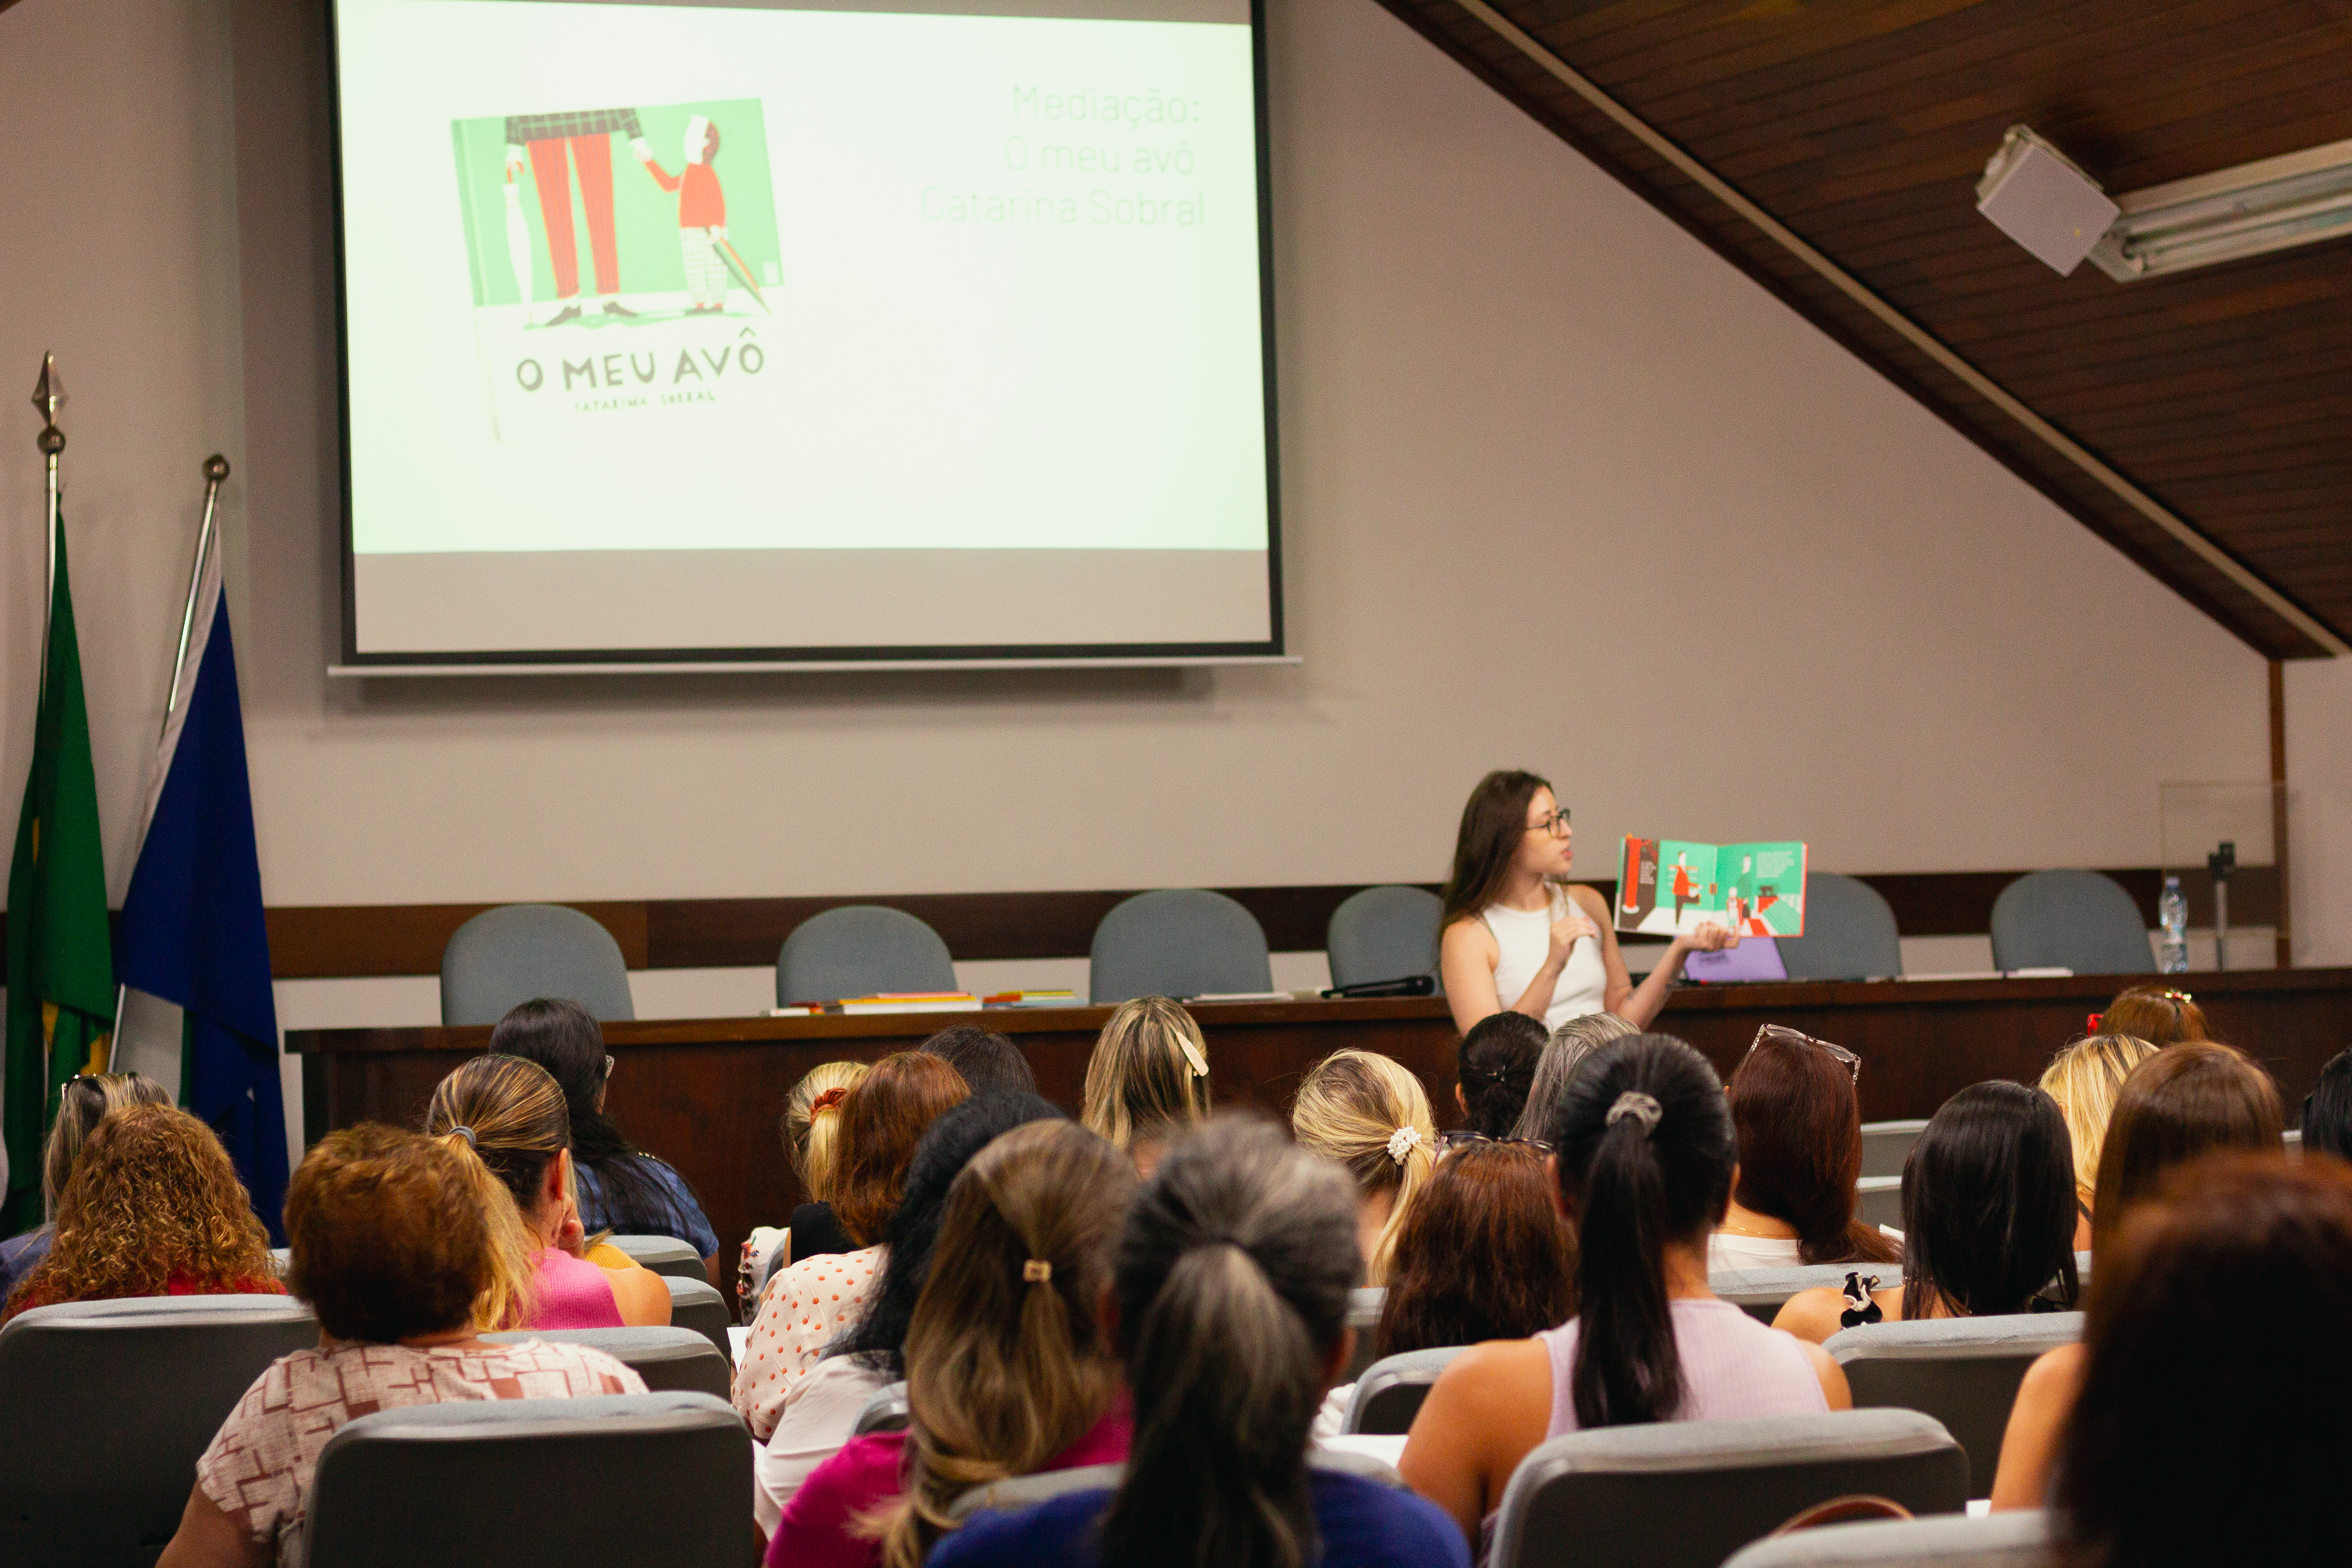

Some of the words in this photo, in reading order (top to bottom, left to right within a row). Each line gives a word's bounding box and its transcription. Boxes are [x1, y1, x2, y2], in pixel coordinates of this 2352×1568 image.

[1013, 84, 1200, 130] Mediação:
[1004, 134, 1029, 171] O
[1042, 144, 1121, 173] meu
[1132, 140, 1195, 175] avô
[921, 185, 1078, 224] Catarina
[1088, 188, 1205, 226] Sobral
[516, 358, 544, 392] O
[562, 351, 655, 392] MEU
[674, 326, 764, 385] AVÔ
